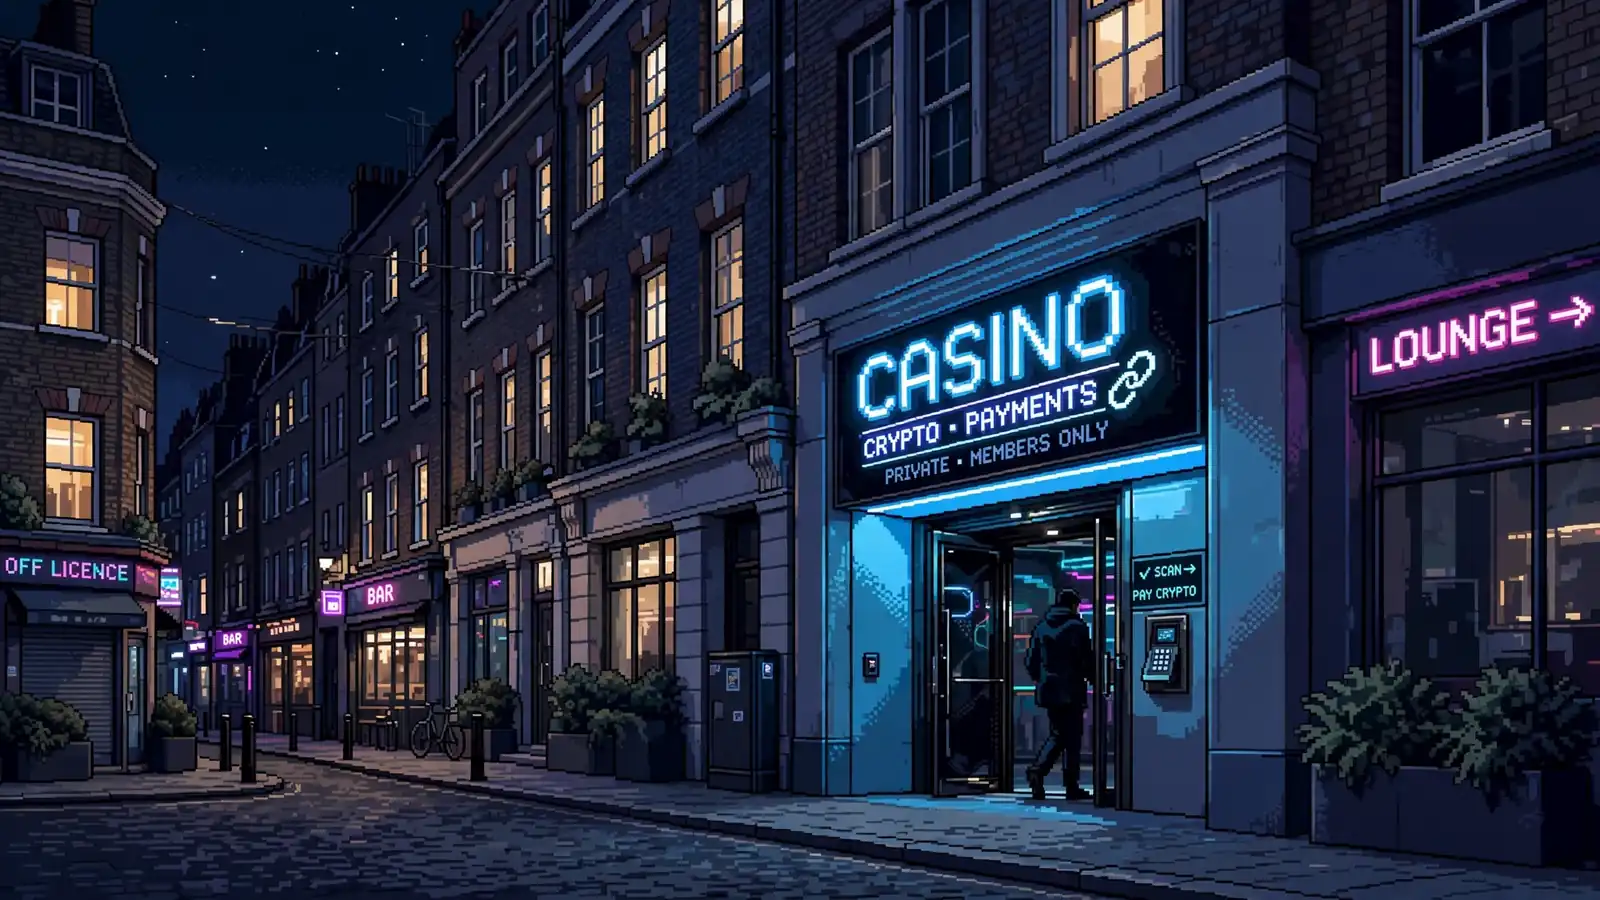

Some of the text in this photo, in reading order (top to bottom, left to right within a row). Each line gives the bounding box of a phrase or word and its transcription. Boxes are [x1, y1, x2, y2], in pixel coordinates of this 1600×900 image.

[857, 273, 1126, 420] CASINO
[1370, 298, 1538, 376] LOUNGE
[863, 380, 1098, 460] CRYPTO PAYMENTS
[885, 420, 1109, 485] PRIVATE MEMBERS ONLY
[5, 557, 129, 581] OFF LICENCE
[1154, 564, 1182, 578] SCAN
[367, 583, 395, 605] BAR
[1132, 585, 1197, 602] PAY CRYPTO
[222, 631, 242, 646] BAR
